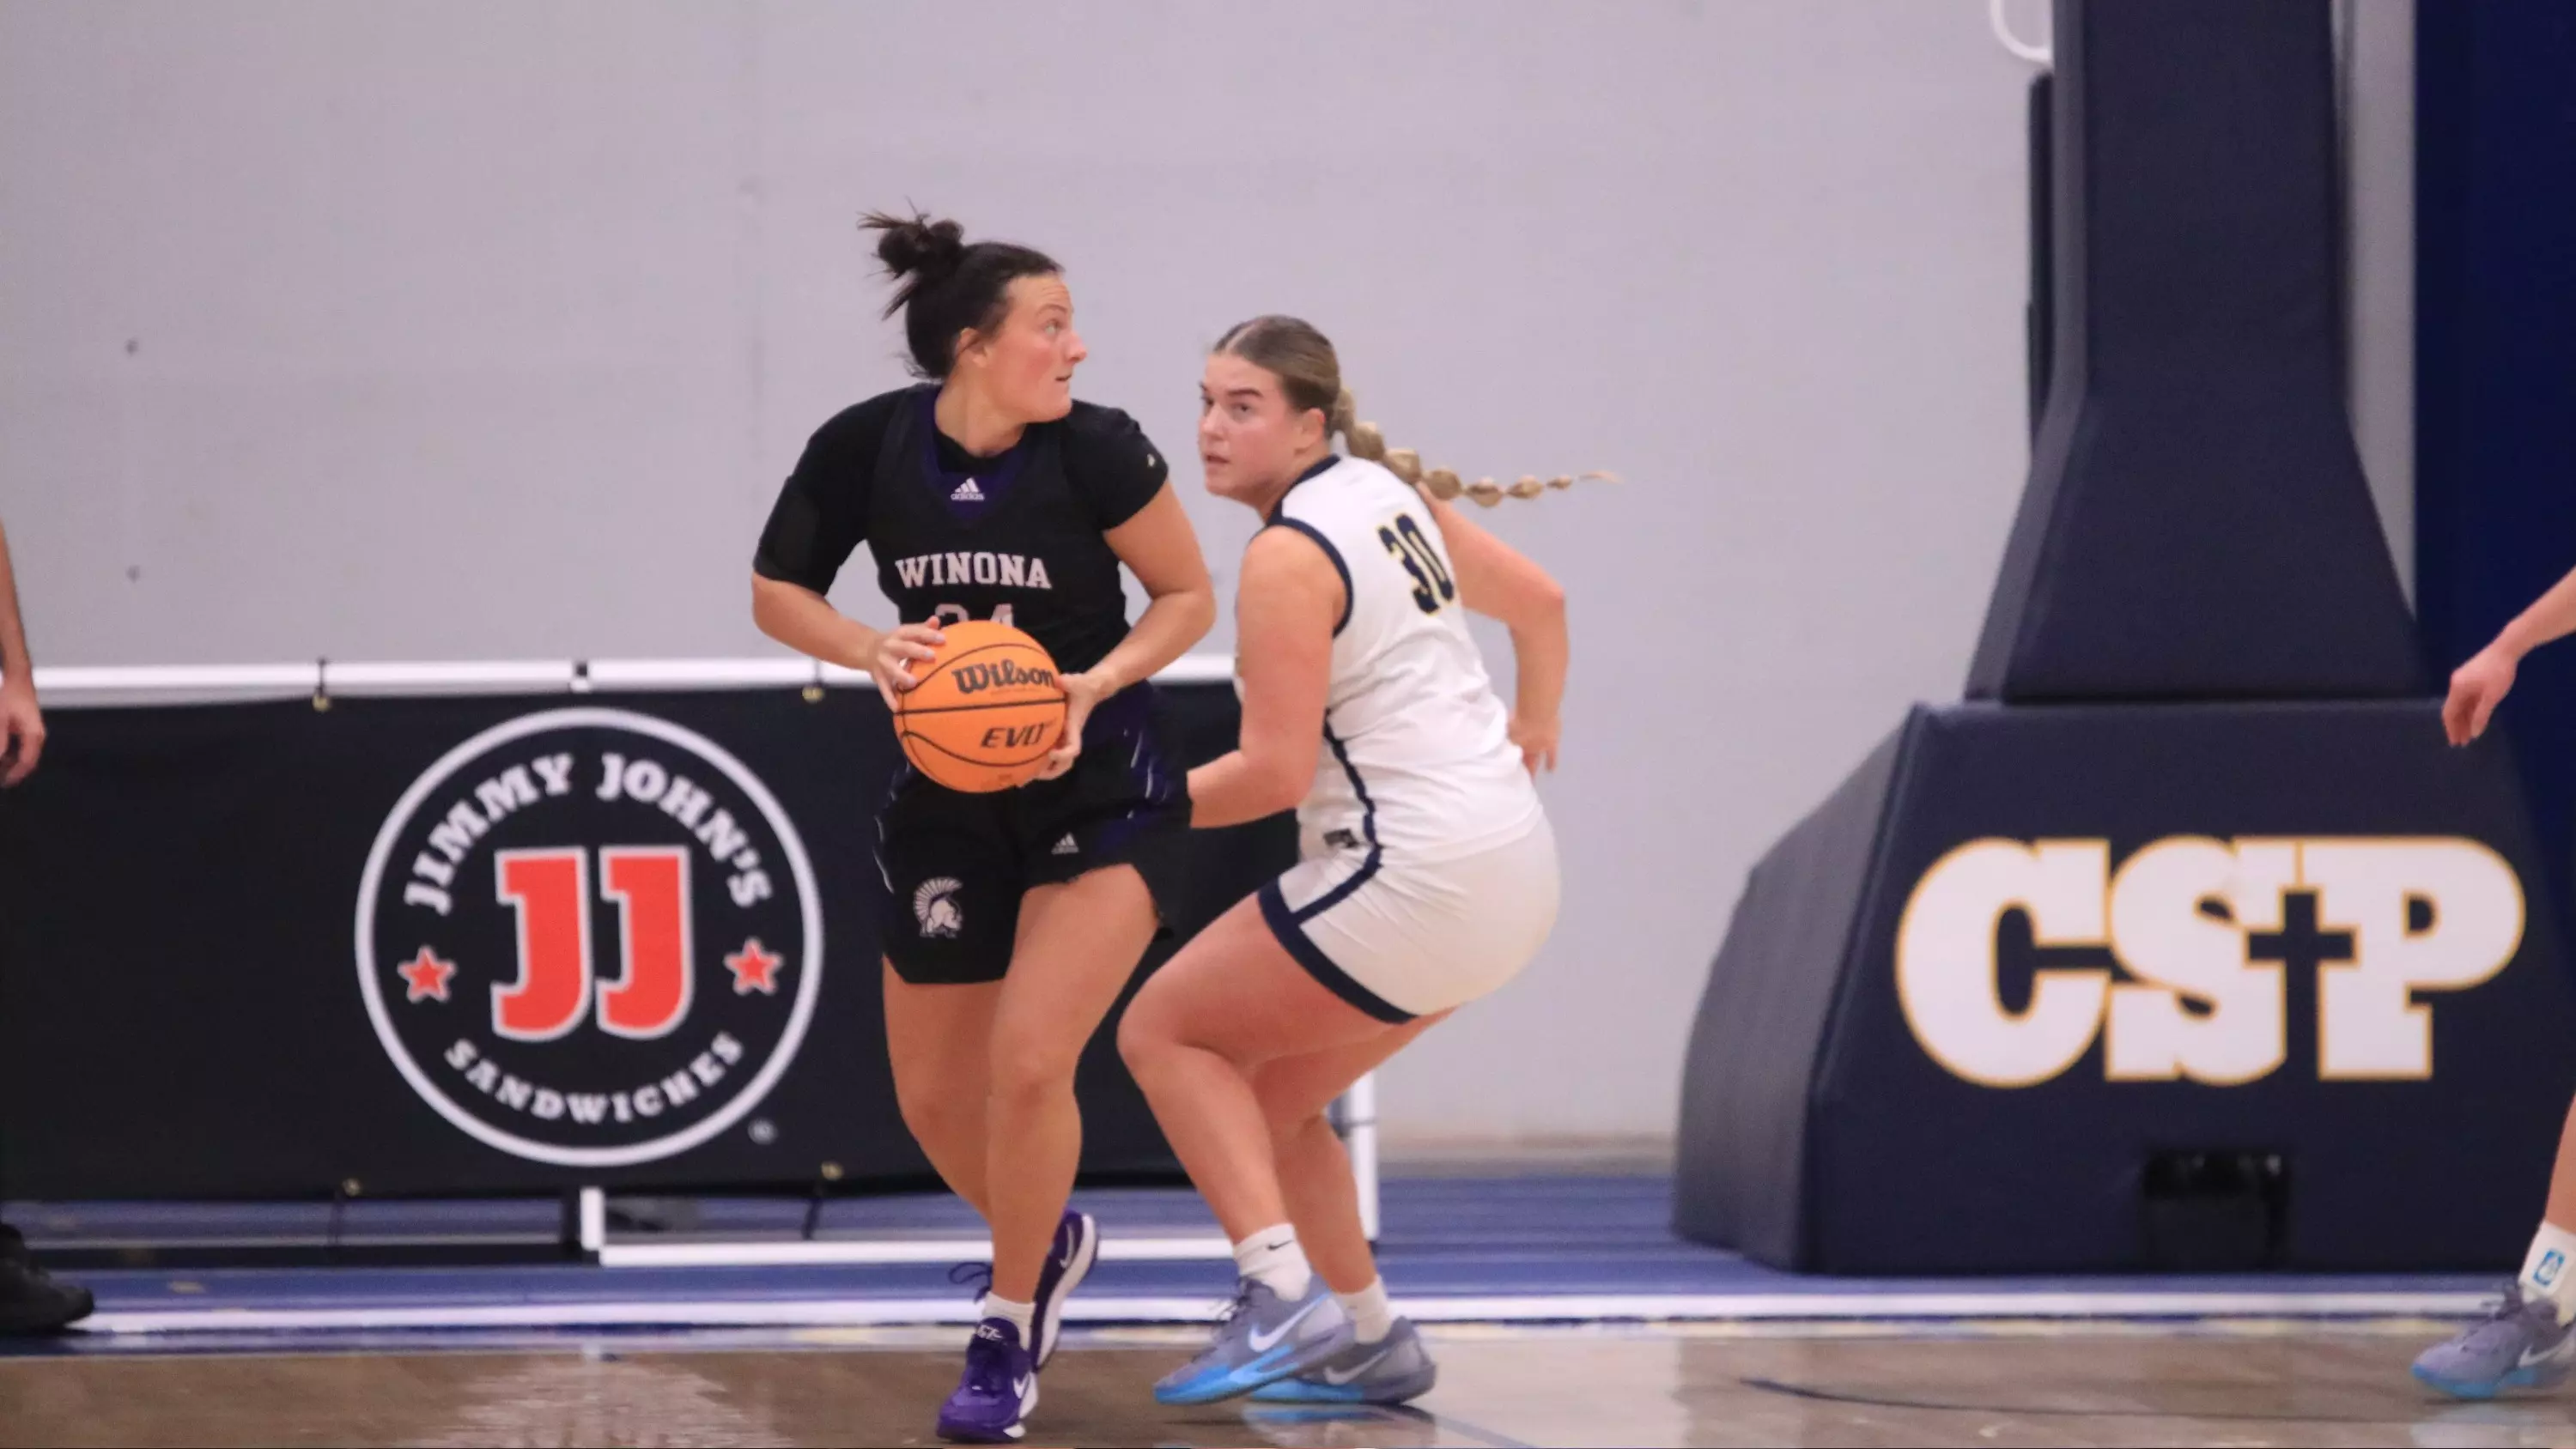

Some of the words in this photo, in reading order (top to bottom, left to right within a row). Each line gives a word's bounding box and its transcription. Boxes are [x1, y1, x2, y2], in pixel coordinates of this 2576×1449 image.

[950, 493, 985, 501] adidas
[895, 552, 1052, 589] WINONA
[1376, 512, 1455, 615] 30
[951, 658, 1055, 694] Wilson
[404, 753, 574, 915] JIMMY
[596, 753, 771, 908] JOHN'S
[490, 846, 695, 1041] JJ
[444, 1031, 744, 1123] SANDWICHES
